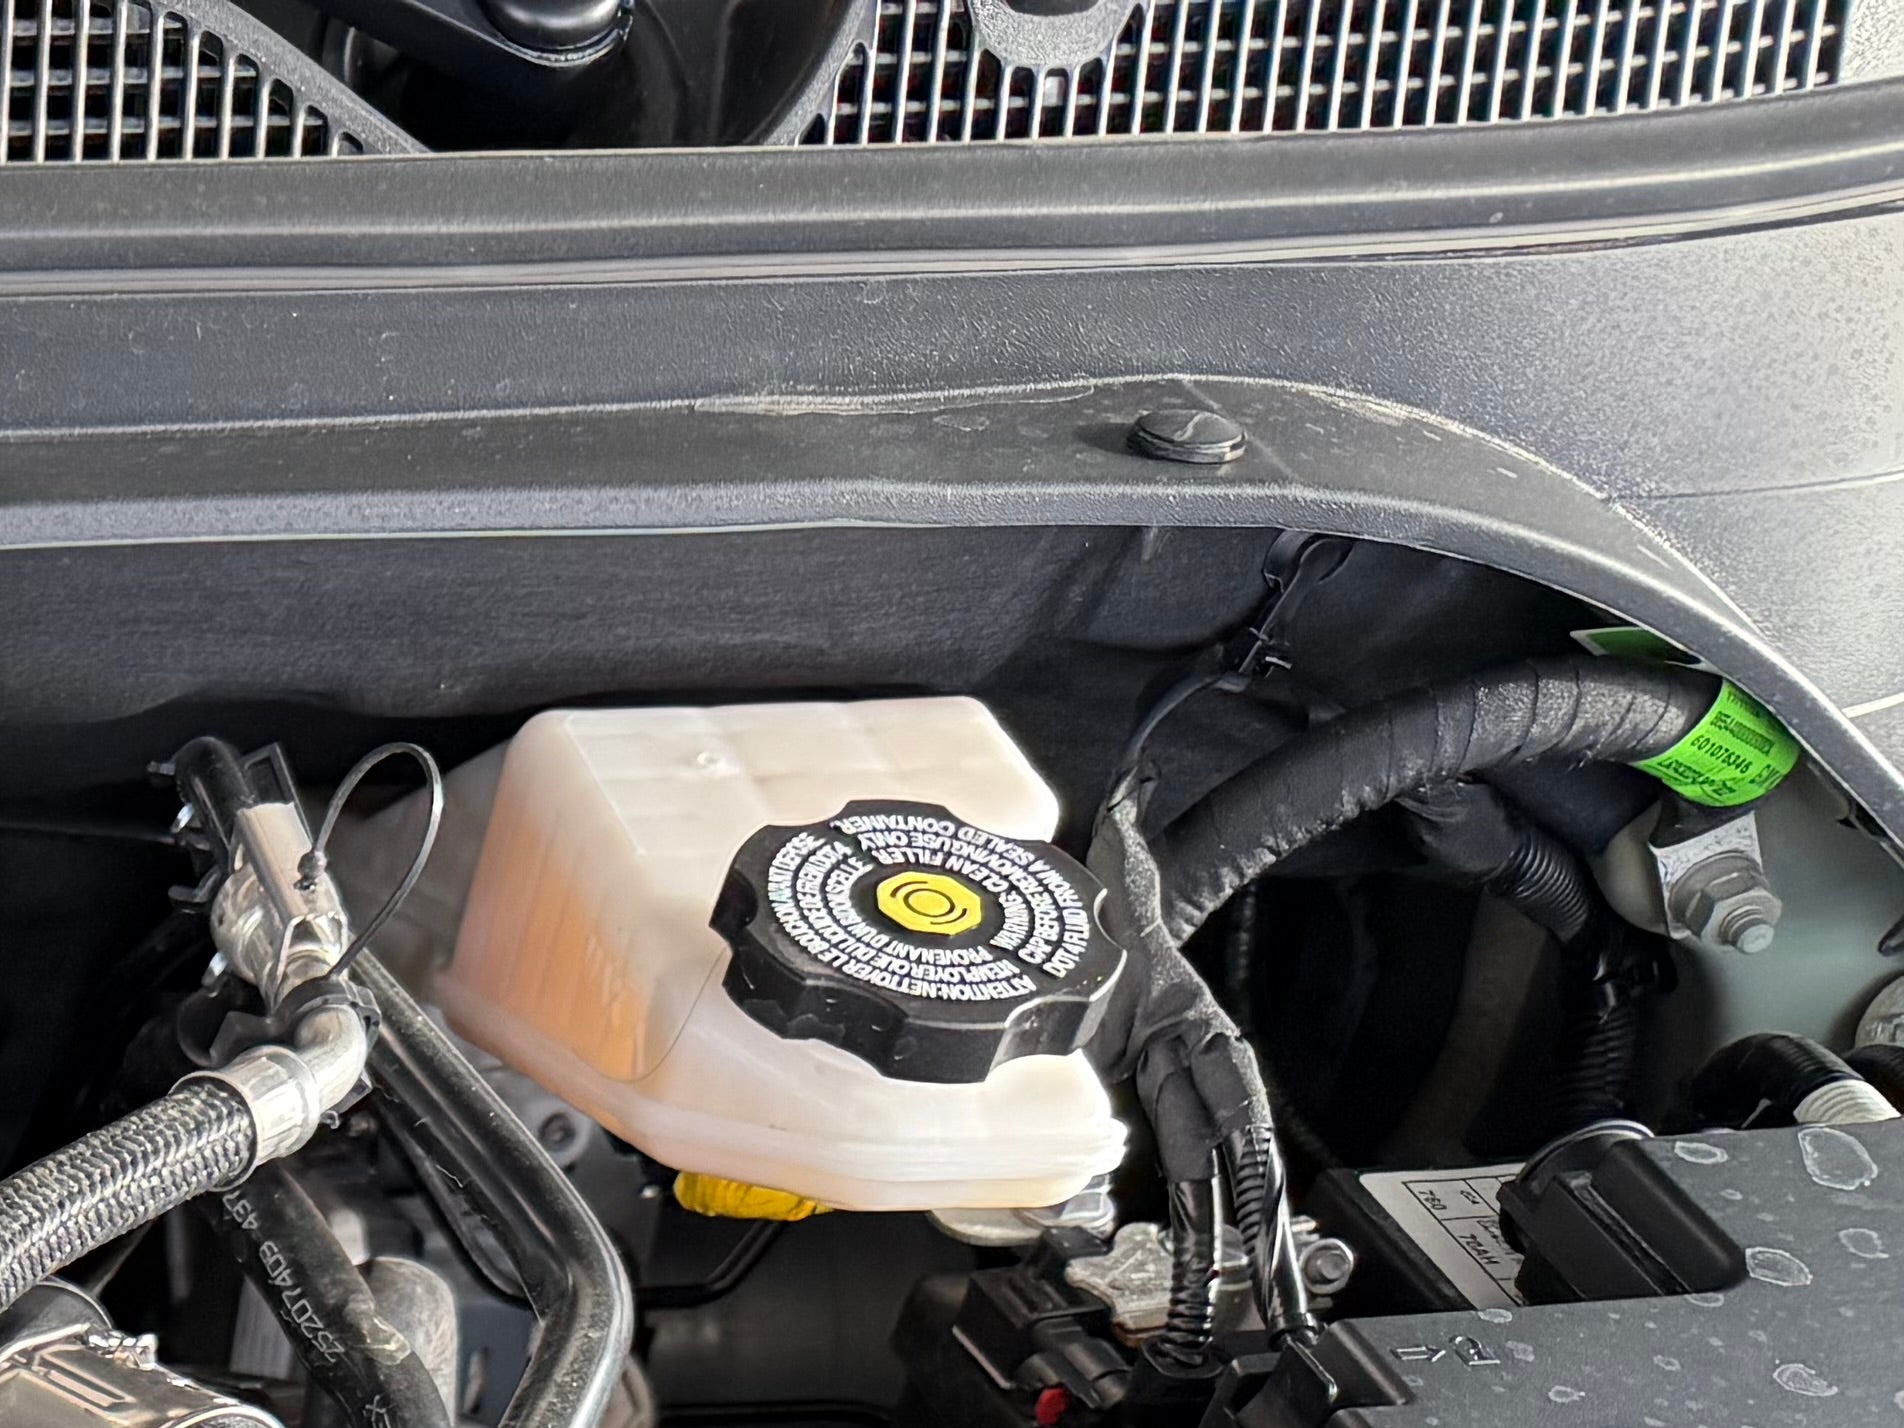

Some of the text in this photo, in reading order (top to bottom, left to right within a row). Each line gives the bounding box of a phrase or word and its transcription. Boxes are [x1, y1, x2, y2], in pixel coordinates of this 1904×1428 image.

[853, 832, 910, 849] ONLY
[913, 833, 950, 850] USE
[960, 827, 1035, 865] SEALED
[874, 850, 945, 866] FILLER
[1026, 861, 1049, 873] A
[947, 857, 1010, 892] CLEAN
[1036, 870, 1079, 905] FROM
[799, 894, 822, 907] DE
[773, 904, 828, 953] BOUCHON
[803, 909, 855, 948] LIQUIDE
[1025, 893, 1056, 940] BEFORE
[1061, 909, 1086, 945] FLUID
[818, 949, 847, 966] LE
[844, 943, 875, 961] DU
[883, 940, 995, 964] PROVENANT
[1015, 937, 1052, 964] CAP
[869, 954, 910, 976] QUE
[222, 1190, 259, 1230] 437
